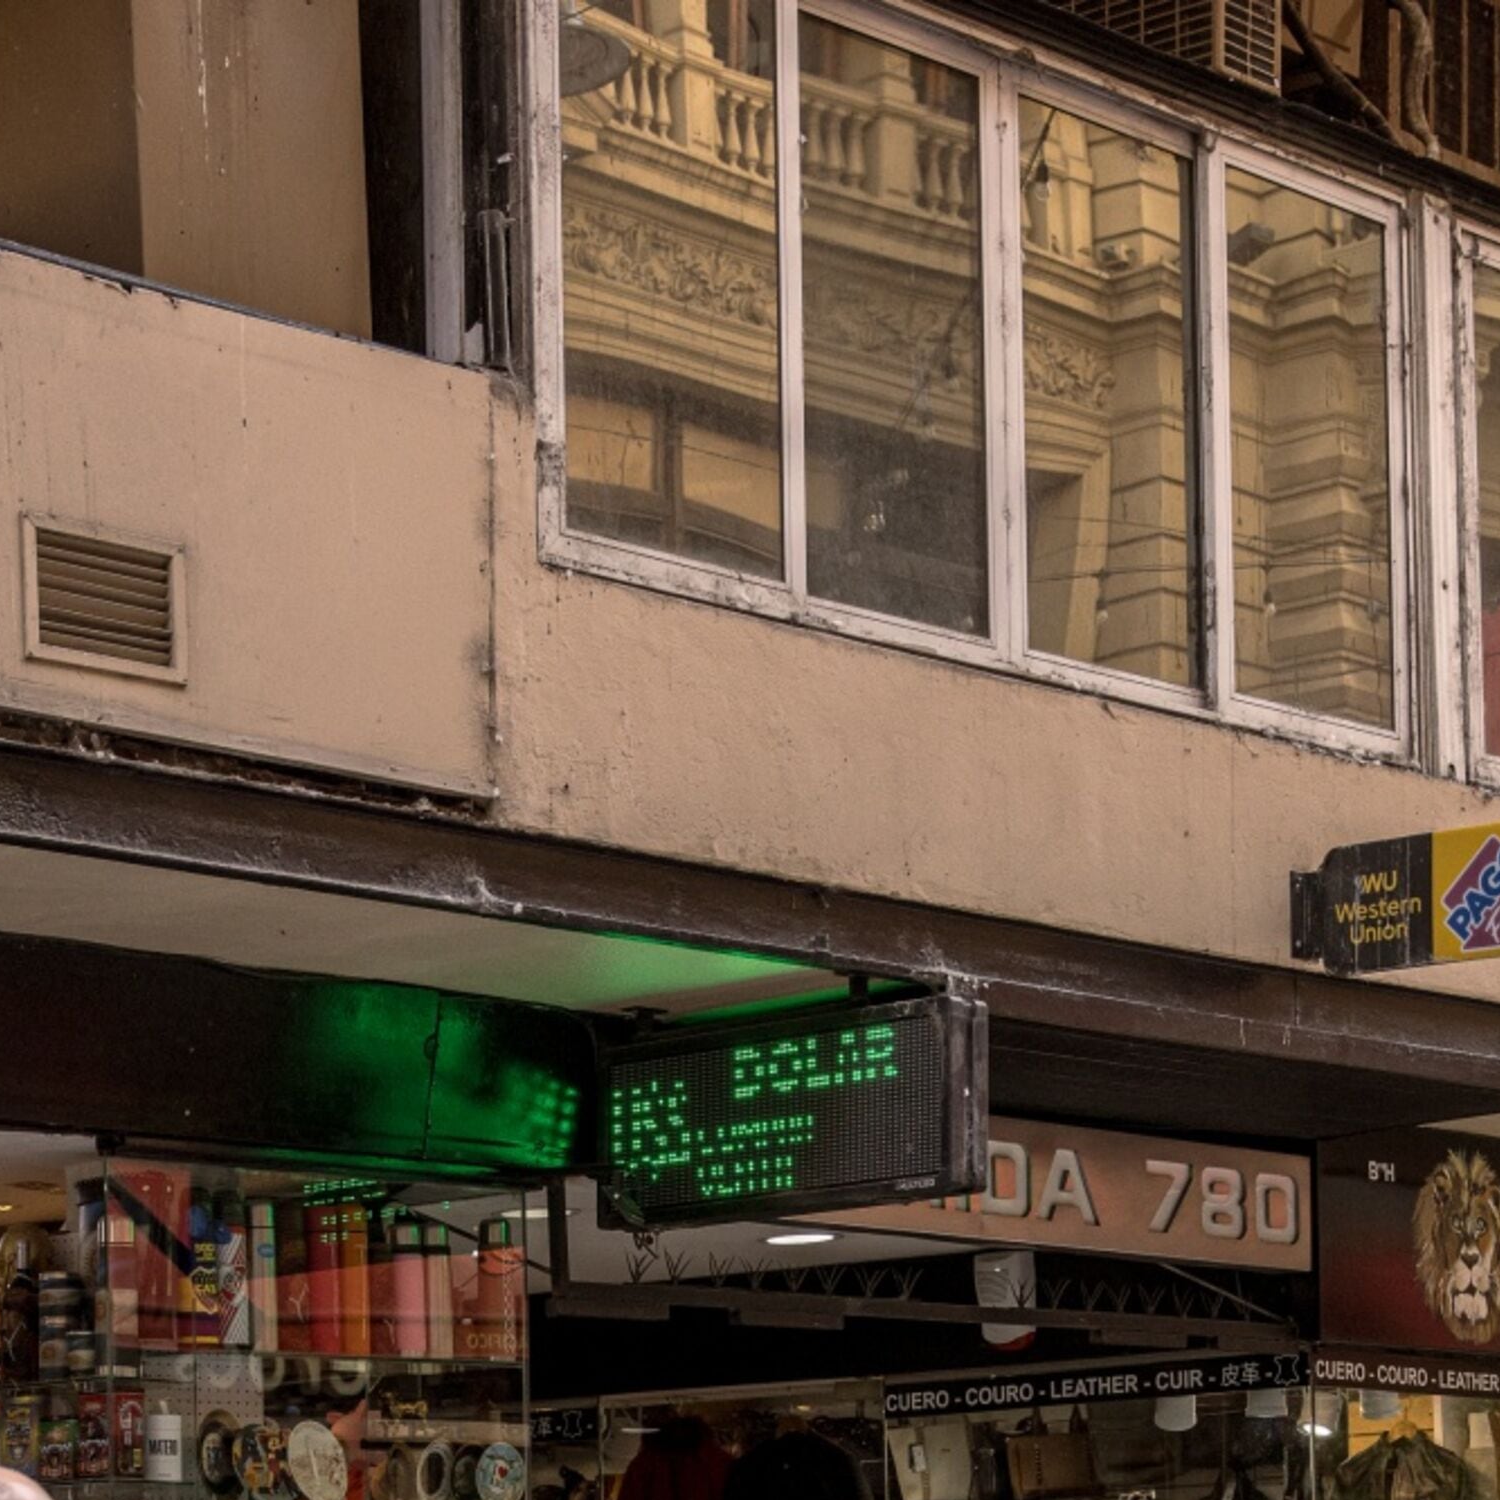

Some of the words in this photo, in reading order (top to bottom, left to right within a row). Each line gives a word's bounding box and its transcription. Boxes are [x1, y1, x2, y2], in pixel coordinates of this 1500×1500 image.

[1335, 894, 1422, 924] Western
[1349, 922, 1409, 945] Union
[1145, 1159, 1296, 1244] 780
[886, 1390, 948, 1412] CUERO
[965, 1384, 1034, 1406] COURO
[1050, 1374, 1138, 1398] LEATHER
[1156, 1369, 1204, 1390] CUIR
[1221, 1363, 1260, 1387] 皮革
[1315, 1360, 1365, 1383] CUERO
[1377, 1365, 1427, 1387] COURO
[1439, 1371, 1499, 1392] LEATHER
